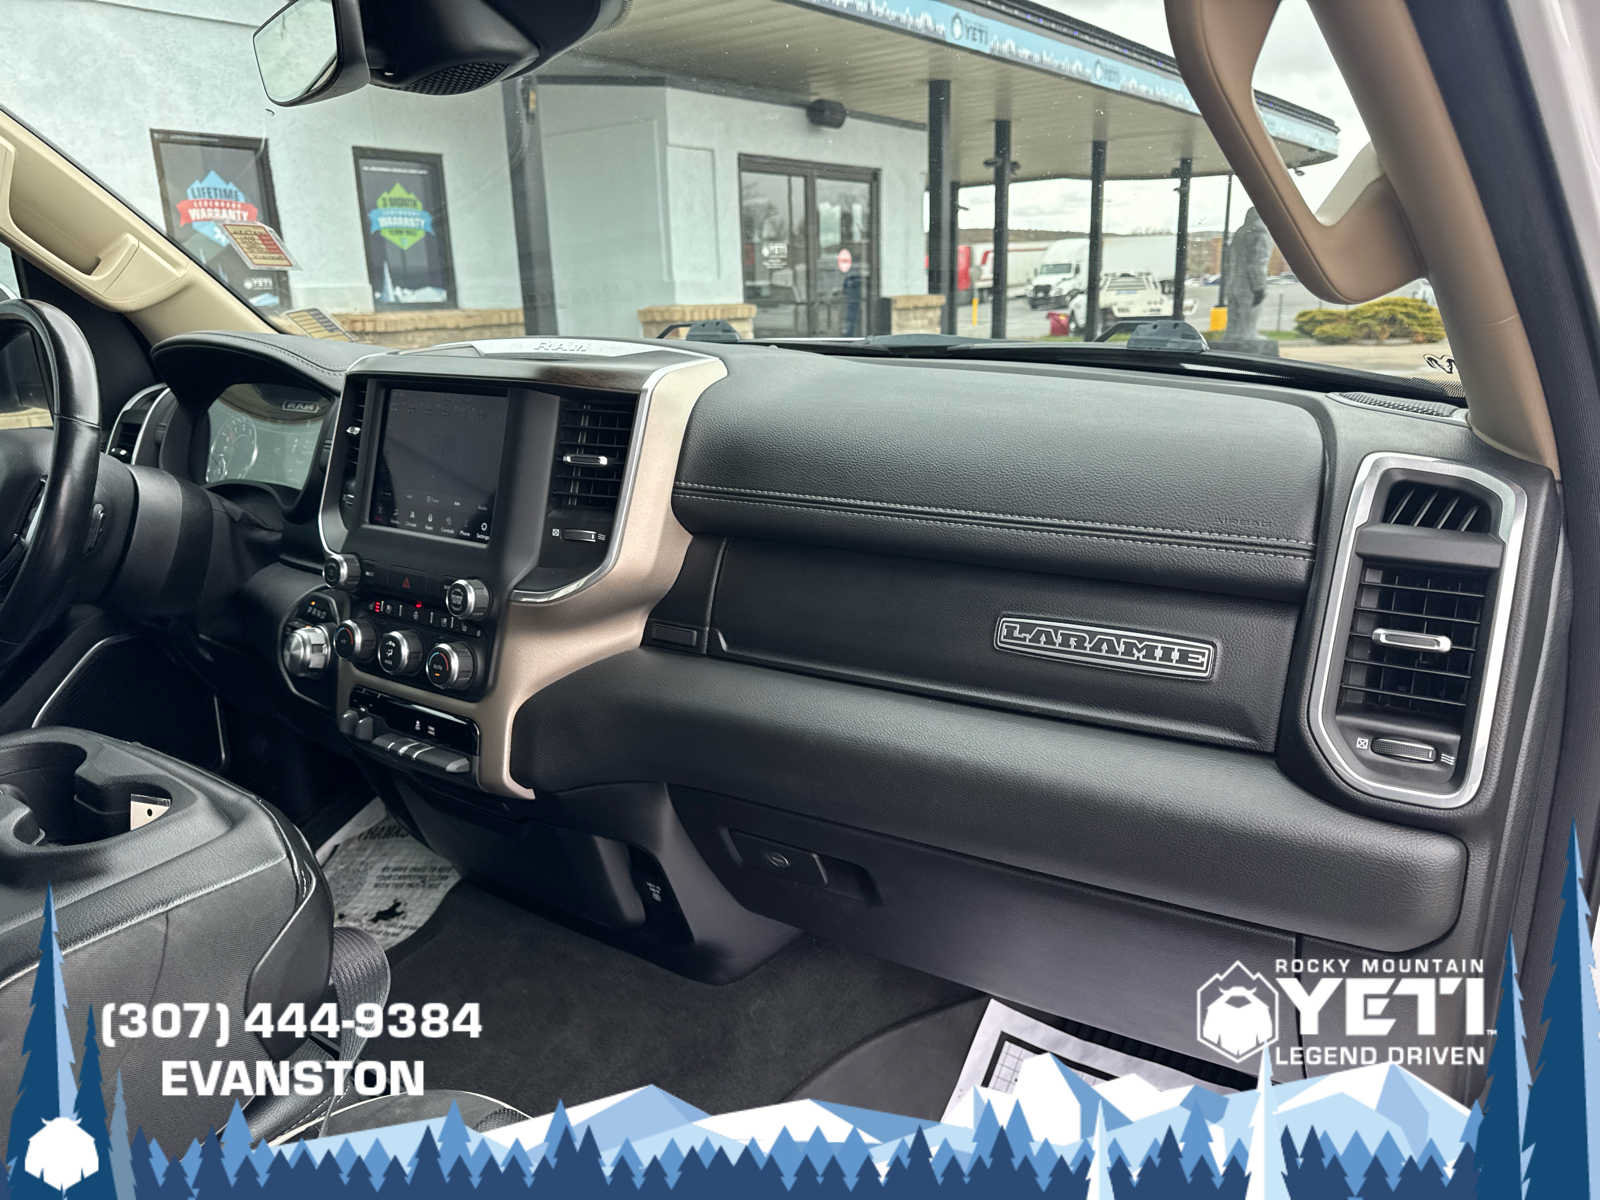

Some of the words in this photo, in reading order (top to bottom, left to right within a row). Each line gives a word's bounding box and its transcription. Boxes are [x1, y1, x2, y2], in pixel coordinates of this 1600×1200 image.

[191, 187, 239, 200] LIFETIME
[188, 208, 249, 221] WARRANTY
[287, 402, 315, 411] RAM
[1001, 623, 1208, 671] LARAMIE
